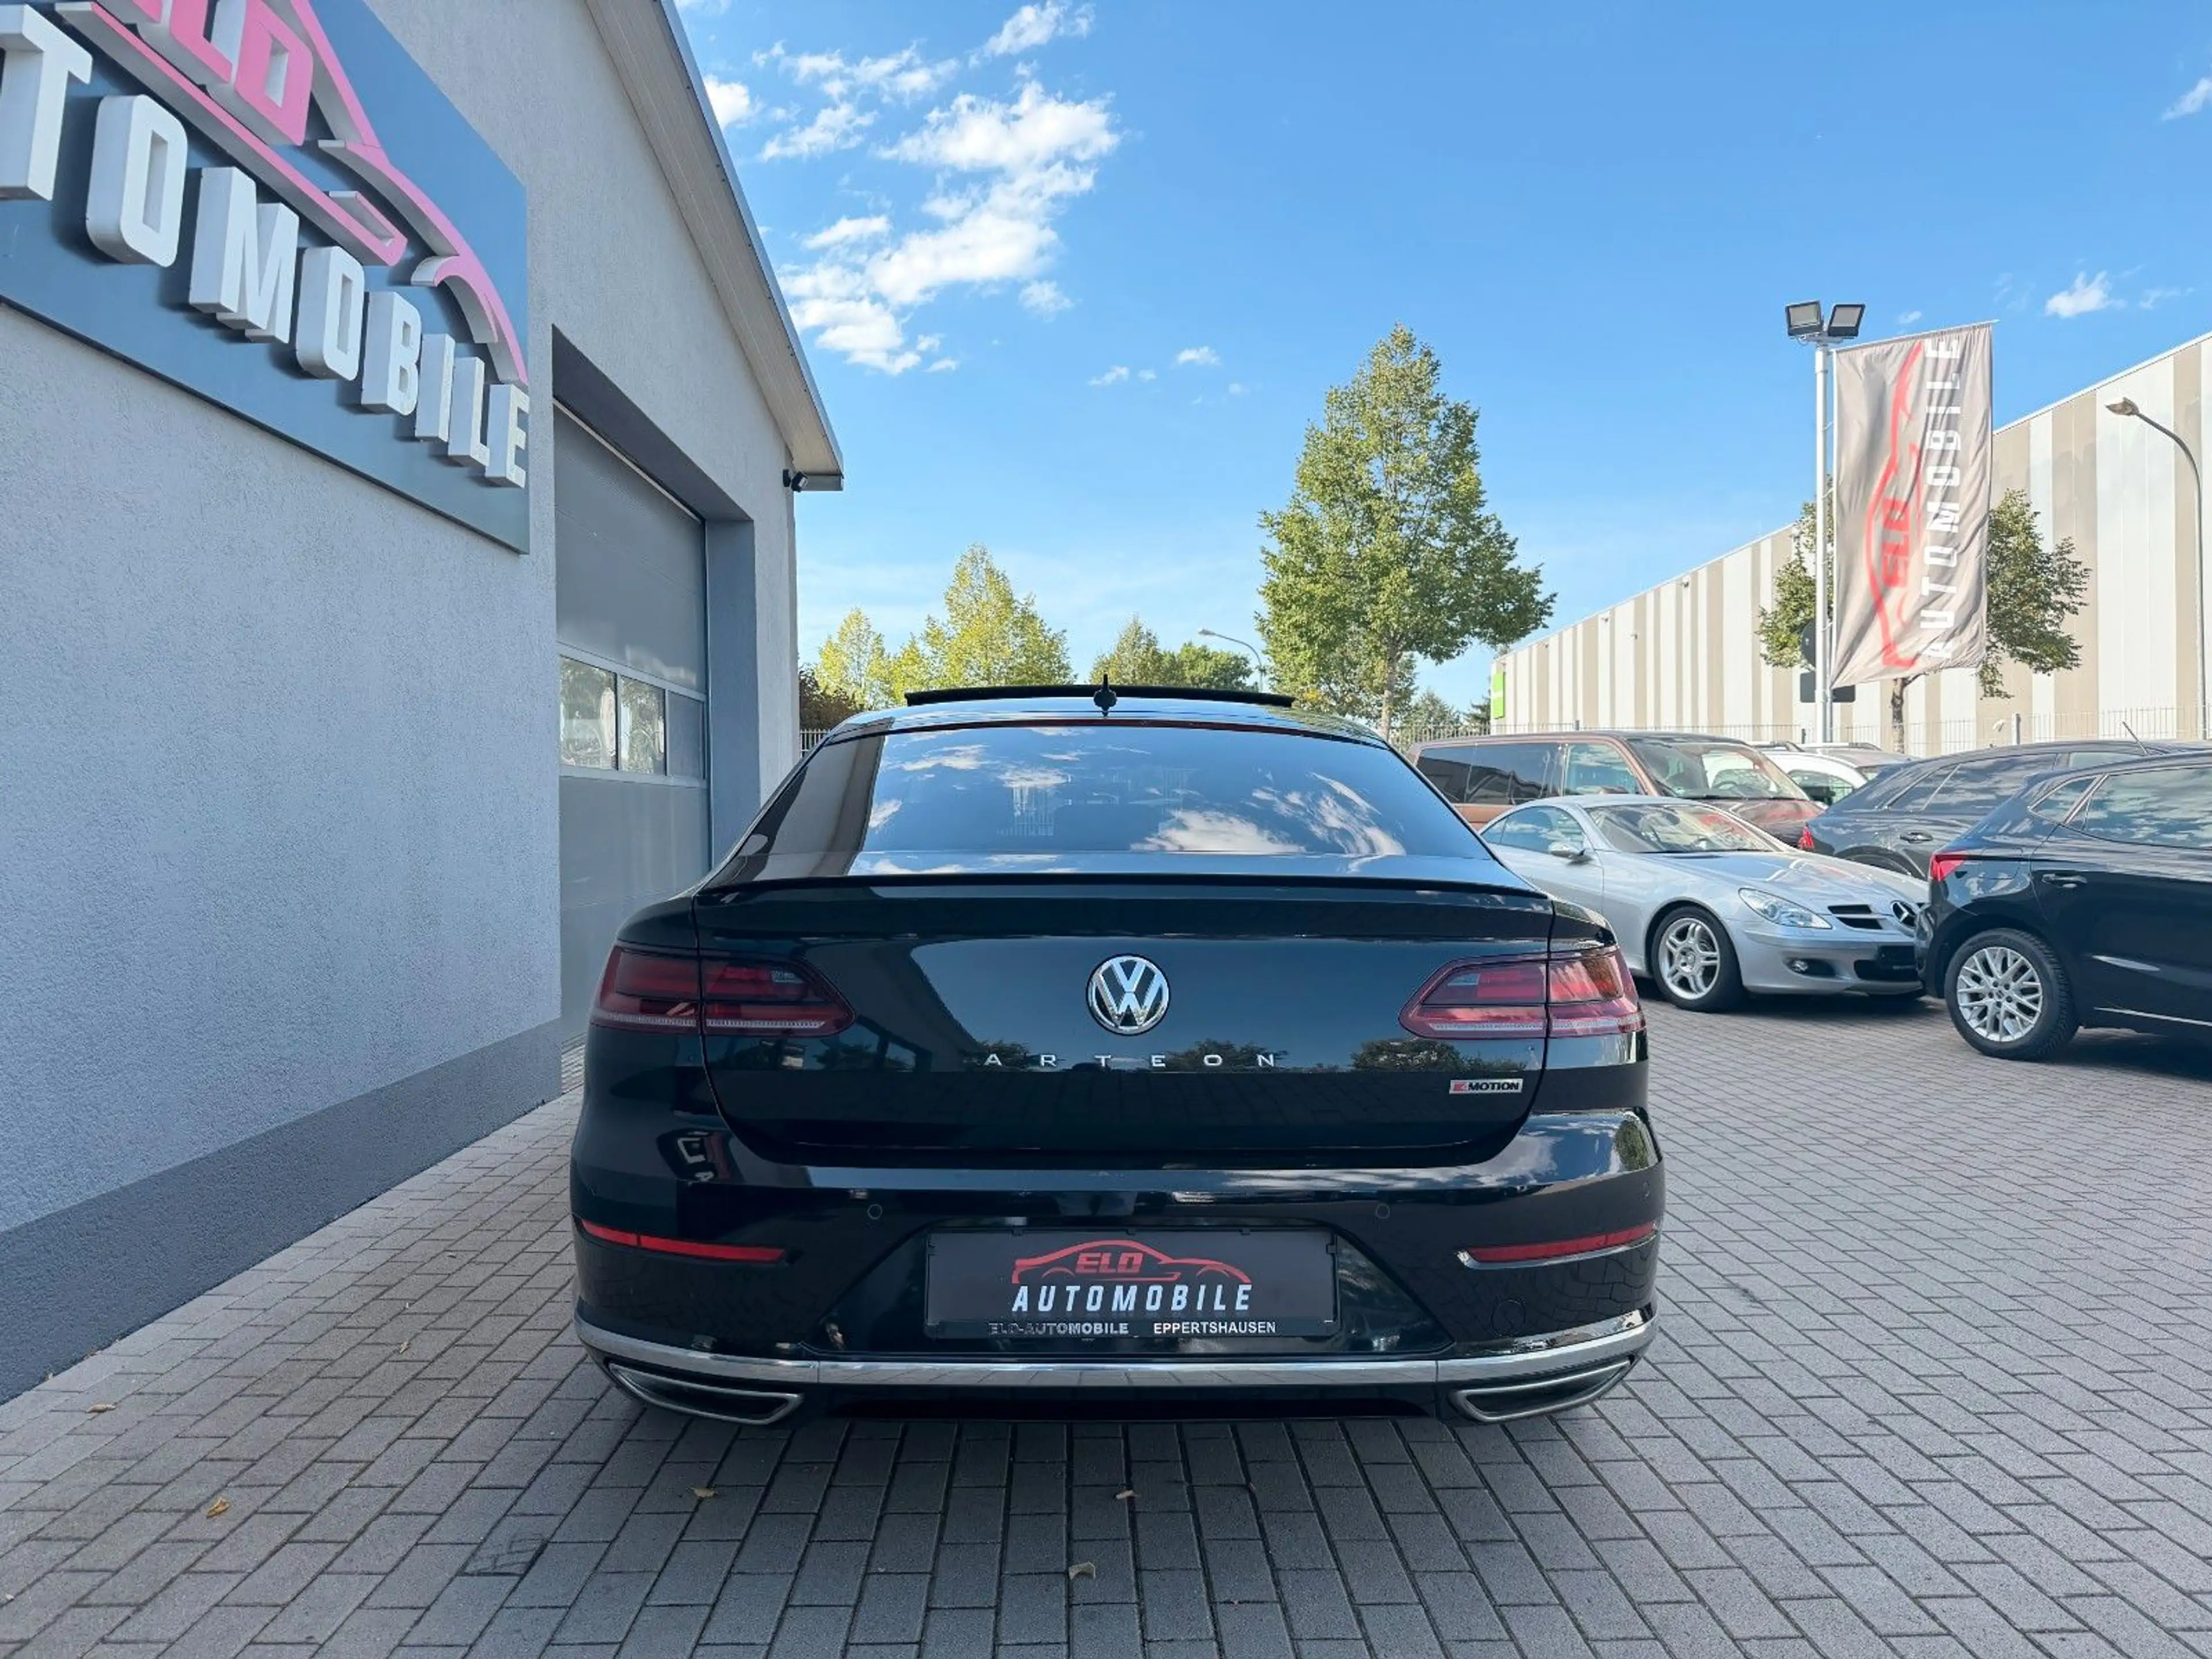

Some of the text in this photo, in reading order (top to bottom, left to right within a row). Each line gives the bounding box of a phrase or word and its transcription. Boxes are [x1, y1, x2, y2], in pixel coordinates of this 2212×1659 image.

[1920, 338, 1961, 659] AUTOMOBILE
[1092, 957, 1165, 1031] VW
[983, 1054, 1275, 1067] ARTEON
[1075, 1252, 1144, 1274] ELD
[1012, 1284, 1252, 1312] AUTOMOBILE
[1153, 1321, 1277, 1335] EPPERTSHAUSEN
